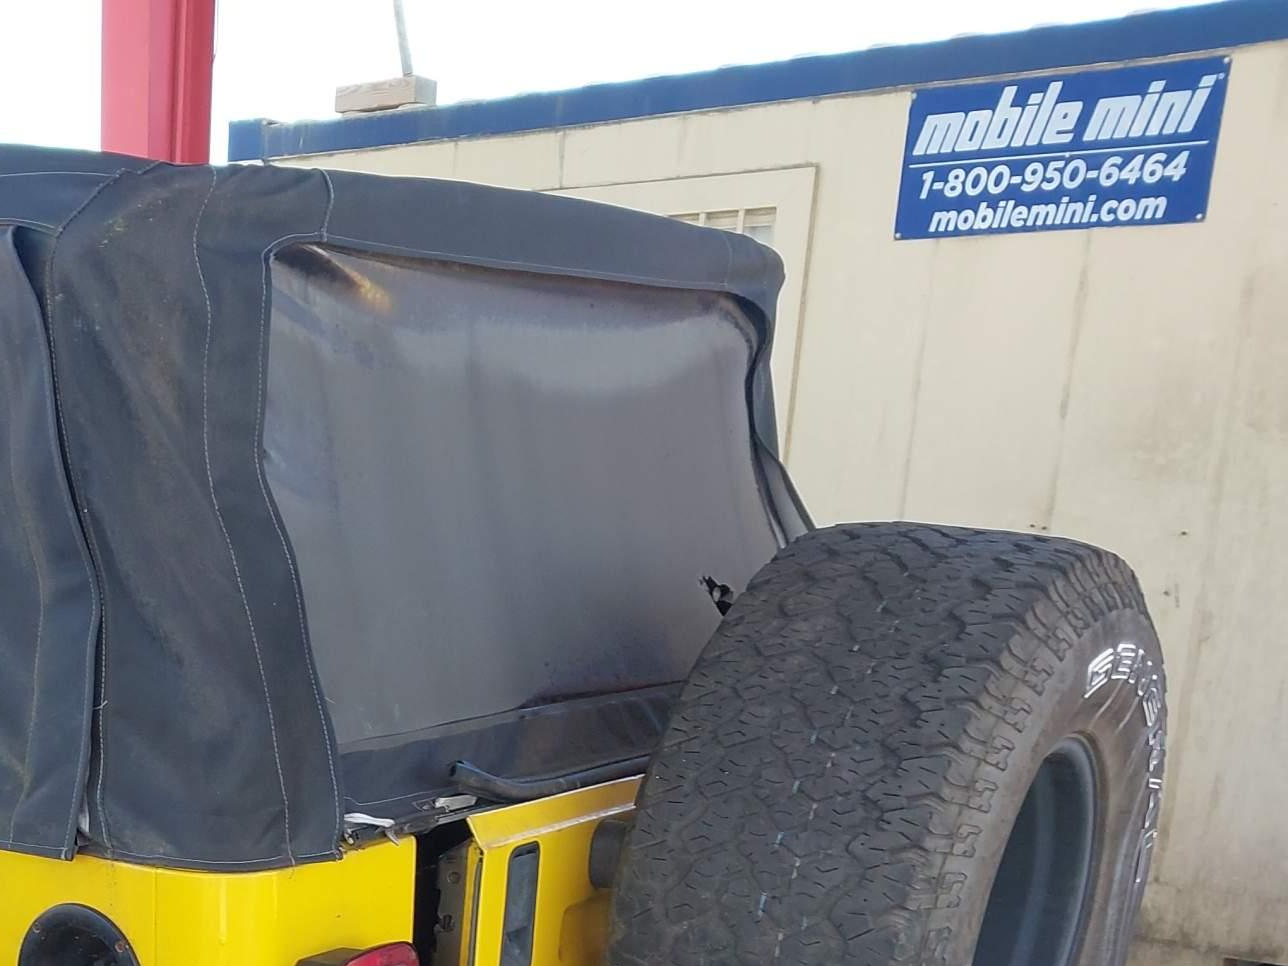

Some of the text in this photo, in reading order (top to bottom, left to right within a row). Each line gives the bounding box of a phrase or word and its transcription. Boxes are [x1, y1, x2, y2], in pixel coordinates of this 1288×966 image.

[912, 74, 1217, 156] mobile mini
[919, 151, 1191, 200] 1-800-950-6464
[928, 195, 1168, 233] mobilemini.com
